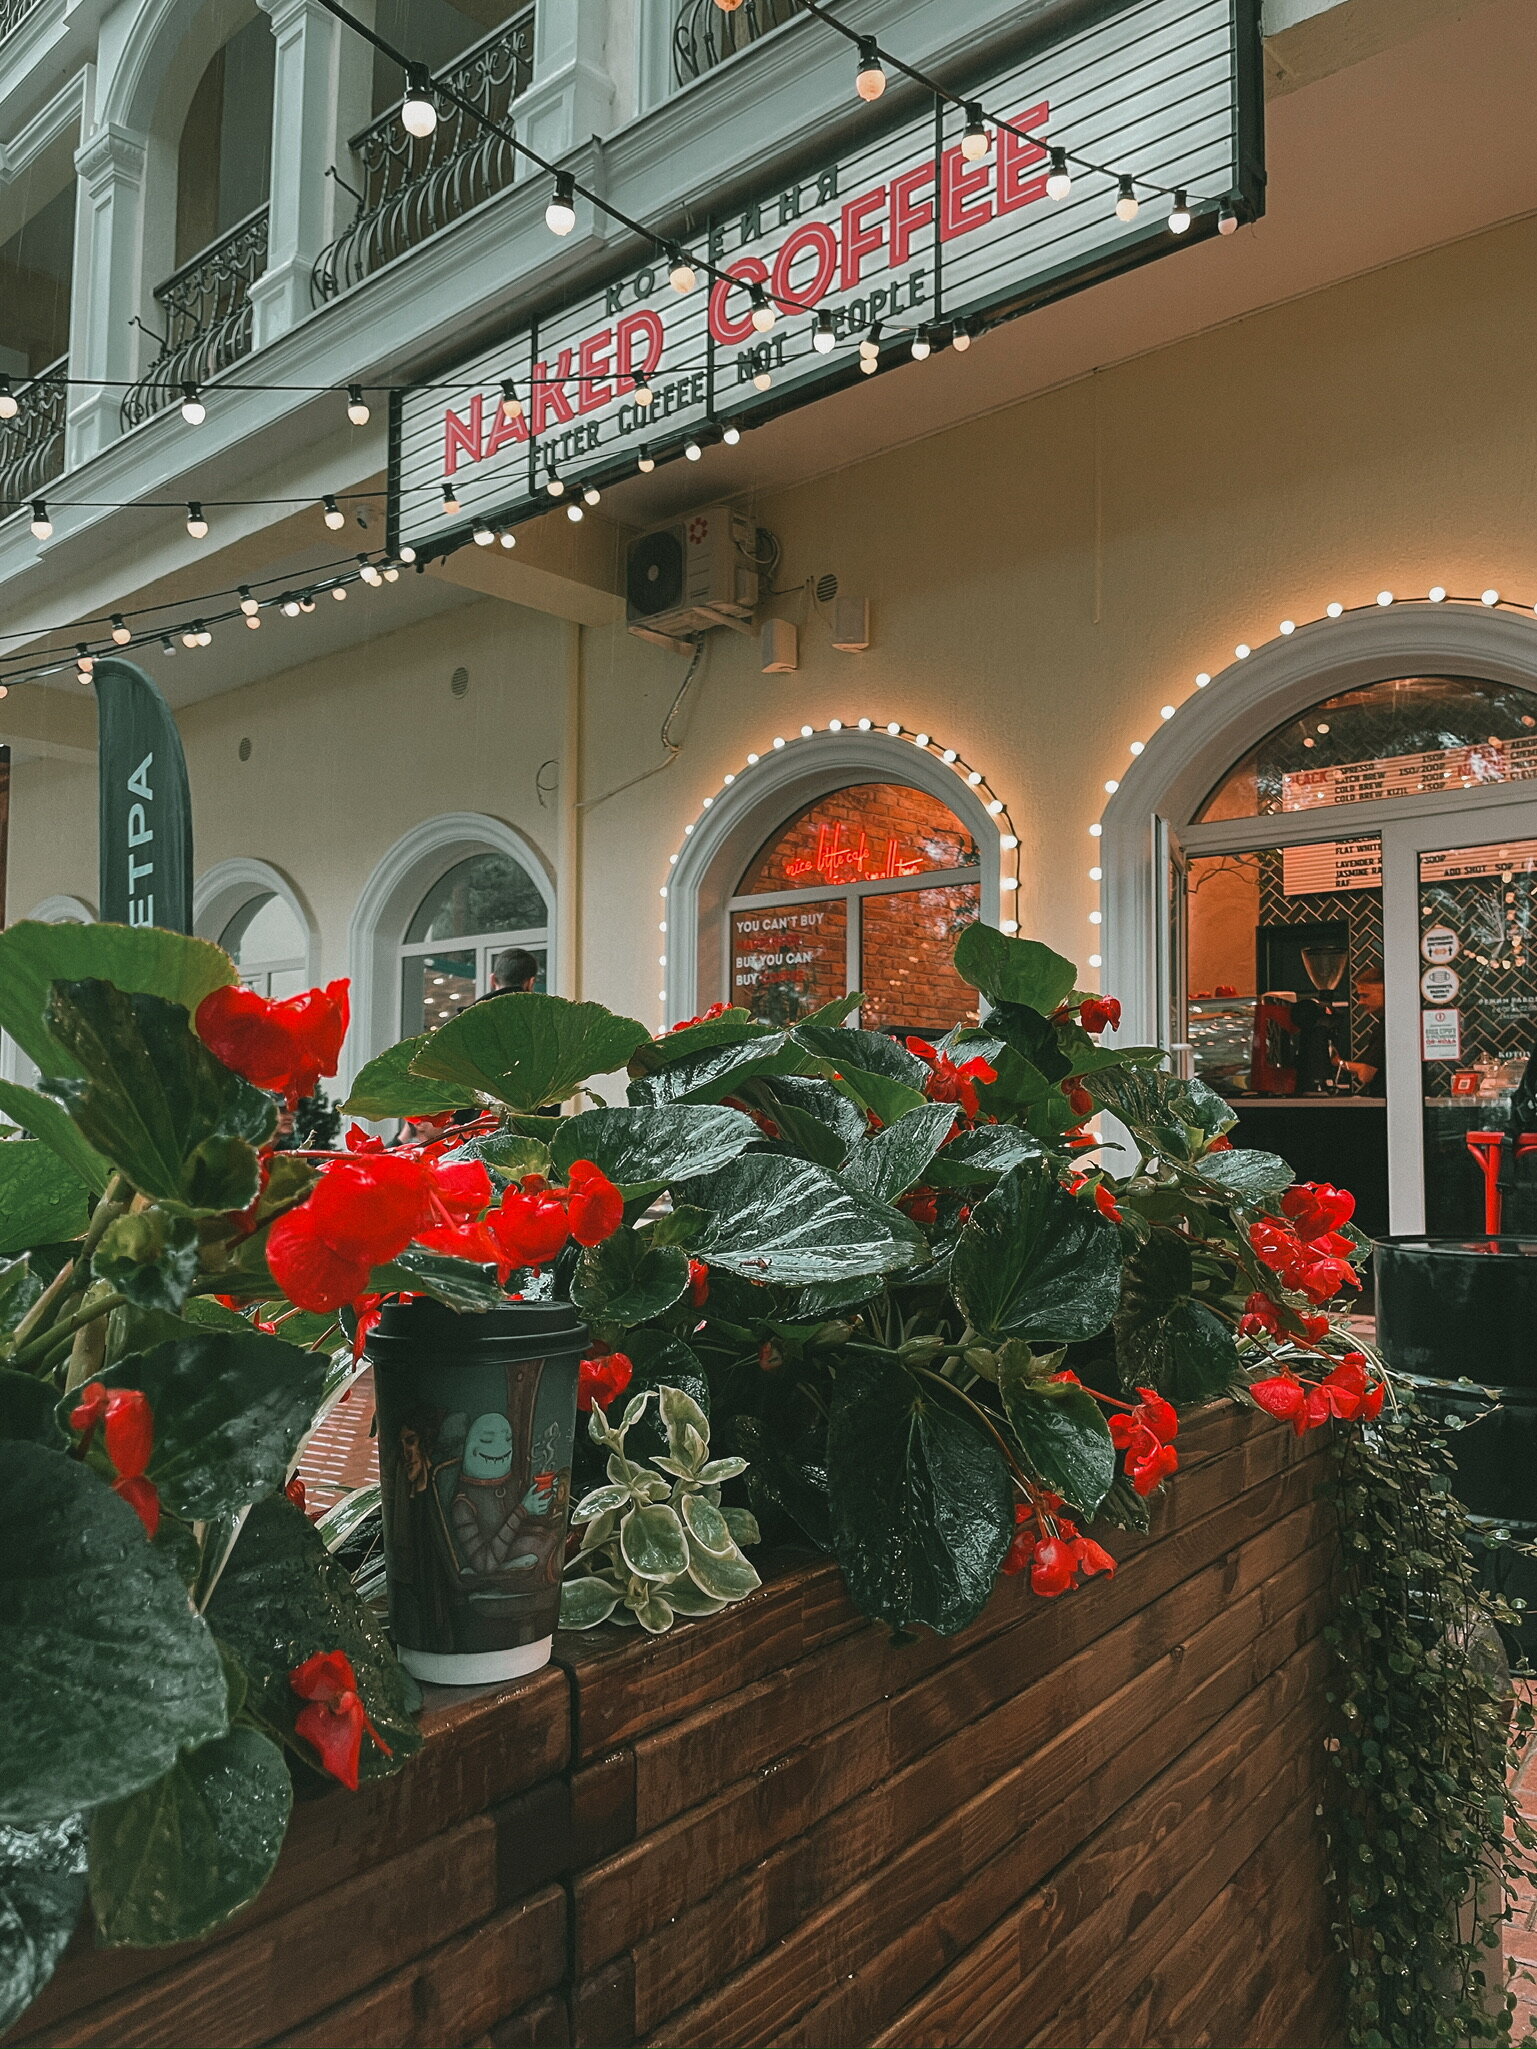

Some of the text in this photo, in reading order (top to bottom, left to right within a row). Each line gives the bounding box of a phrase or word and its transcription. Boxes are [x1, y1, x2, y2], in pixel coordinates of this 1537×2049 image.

[444, 100, 1050, 477] NAKED COFFEE
[530, 419, 601, 468] FILTER
[617, 371, 707, 434] COFFEE
[737, 332, 788, 383] NOT
[1335, 785, 1356, 795] COLD
[1335, 794, 1356, 804] COLD
[785, 858, 813, 876] nice
[846, 832, 870, 872] cafe
[1336, 845, 1354, 855] FLAT
[736, 912, 825, 934] YOU CAN'T BUY
[759, 953, 783, 967] YOU
[785, 951, 813, 964] CAN
[735, 974, 759, 986] BUY
